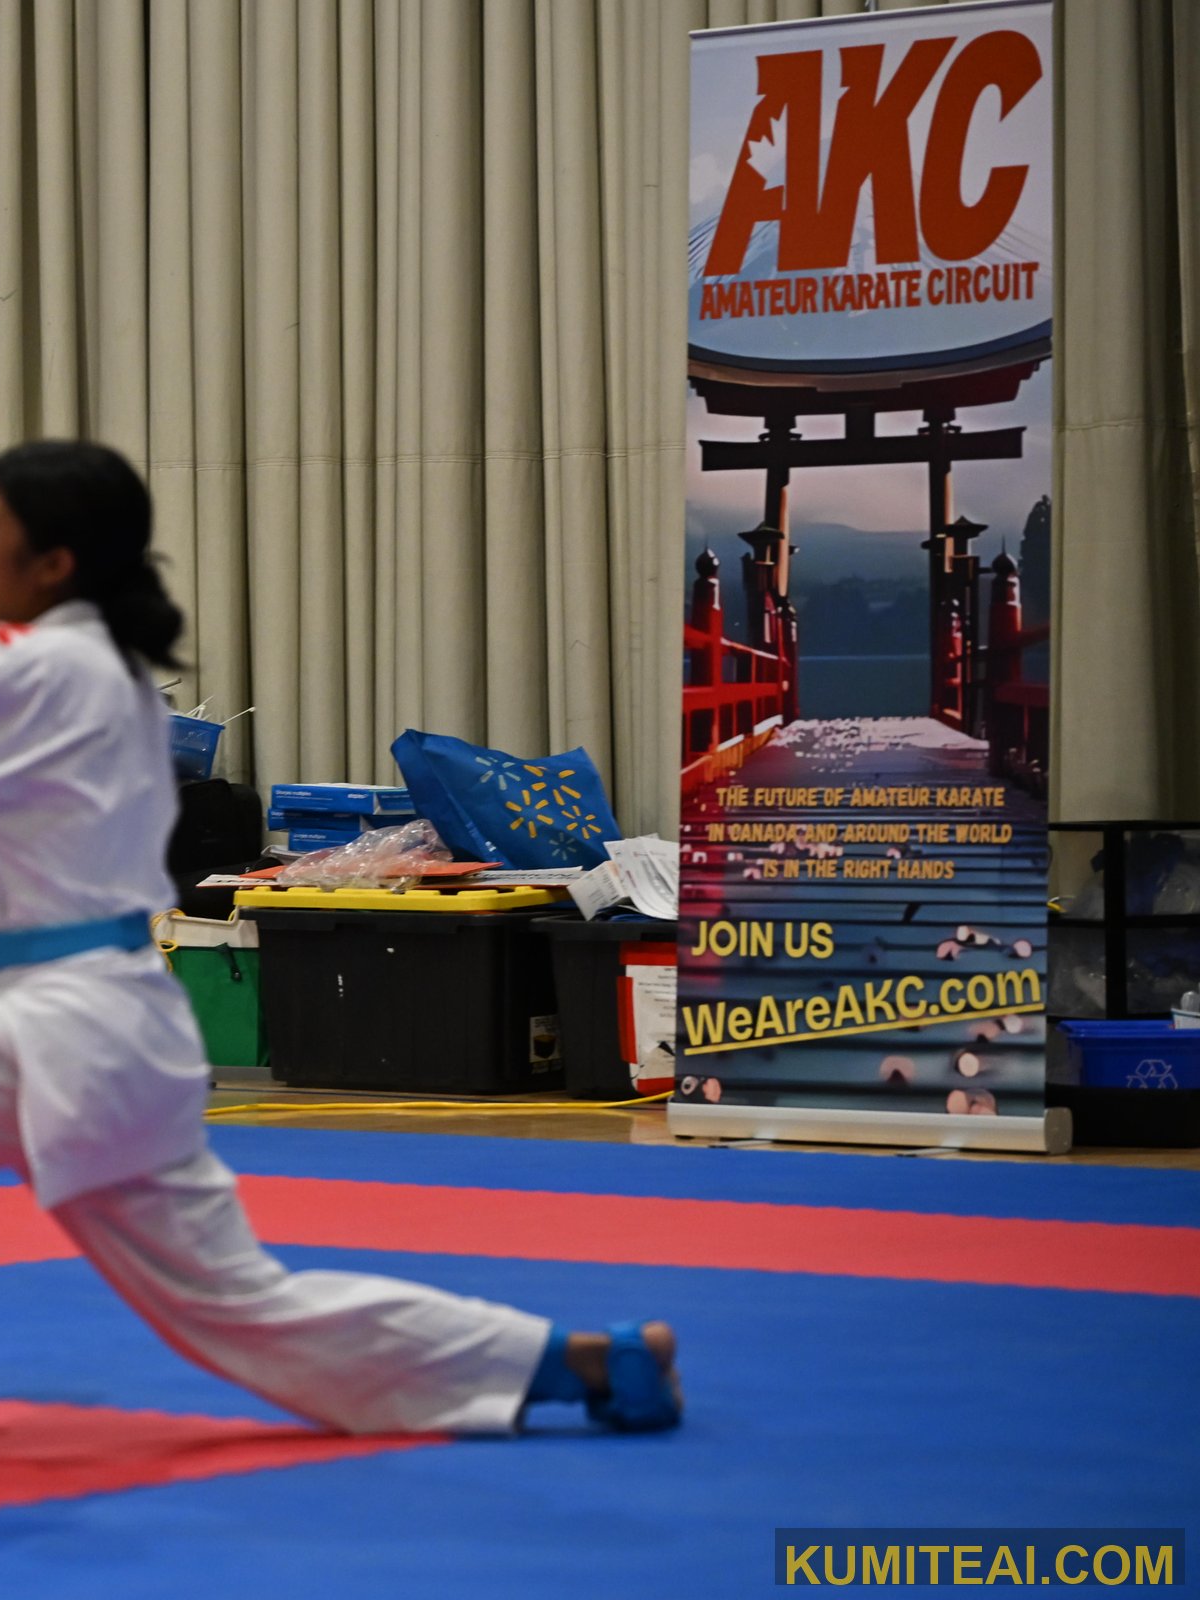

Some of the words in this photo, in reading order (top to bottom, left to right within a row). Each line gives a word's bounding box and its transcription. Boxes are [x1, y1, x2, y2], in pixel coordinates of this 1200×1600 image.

[703, 30, 1043, 277] AKC
[699, 277, 818, 320] AMATEUR
[822, 269, 922, 313] KARATE
[927, 261, 1039, 306] CIRCUIT
[716, 787, 749, 806] THE
[754, 787, 818, 806] FUTURE
[823, 787, 845, 806] OF
[850, 786, 930, 806] AMATEUR
[936, 786, 1005, 806] KARATE
[707, 823, 725, 842] IN
[729, 823, 798, 842] CANADA
[803, 823, 838, 842] AND
[843, 823, 910, 843] AROUND
[915, 823, 950, 843] THE
[955, 823, 1012, 843] WORLD
[763, 858, 778, 878] IS
[783, 858, 799, 878] IN
[806, 859, 838, 879] THE
[843, 859, 892, 879] RIGHT
[897, 859, 955, 880] HANDS
[691, 920, 773, 957] JOIN
[784, 921, 834, 959] US
[682, 967, 1042, 1046] WeAreAKC.com
